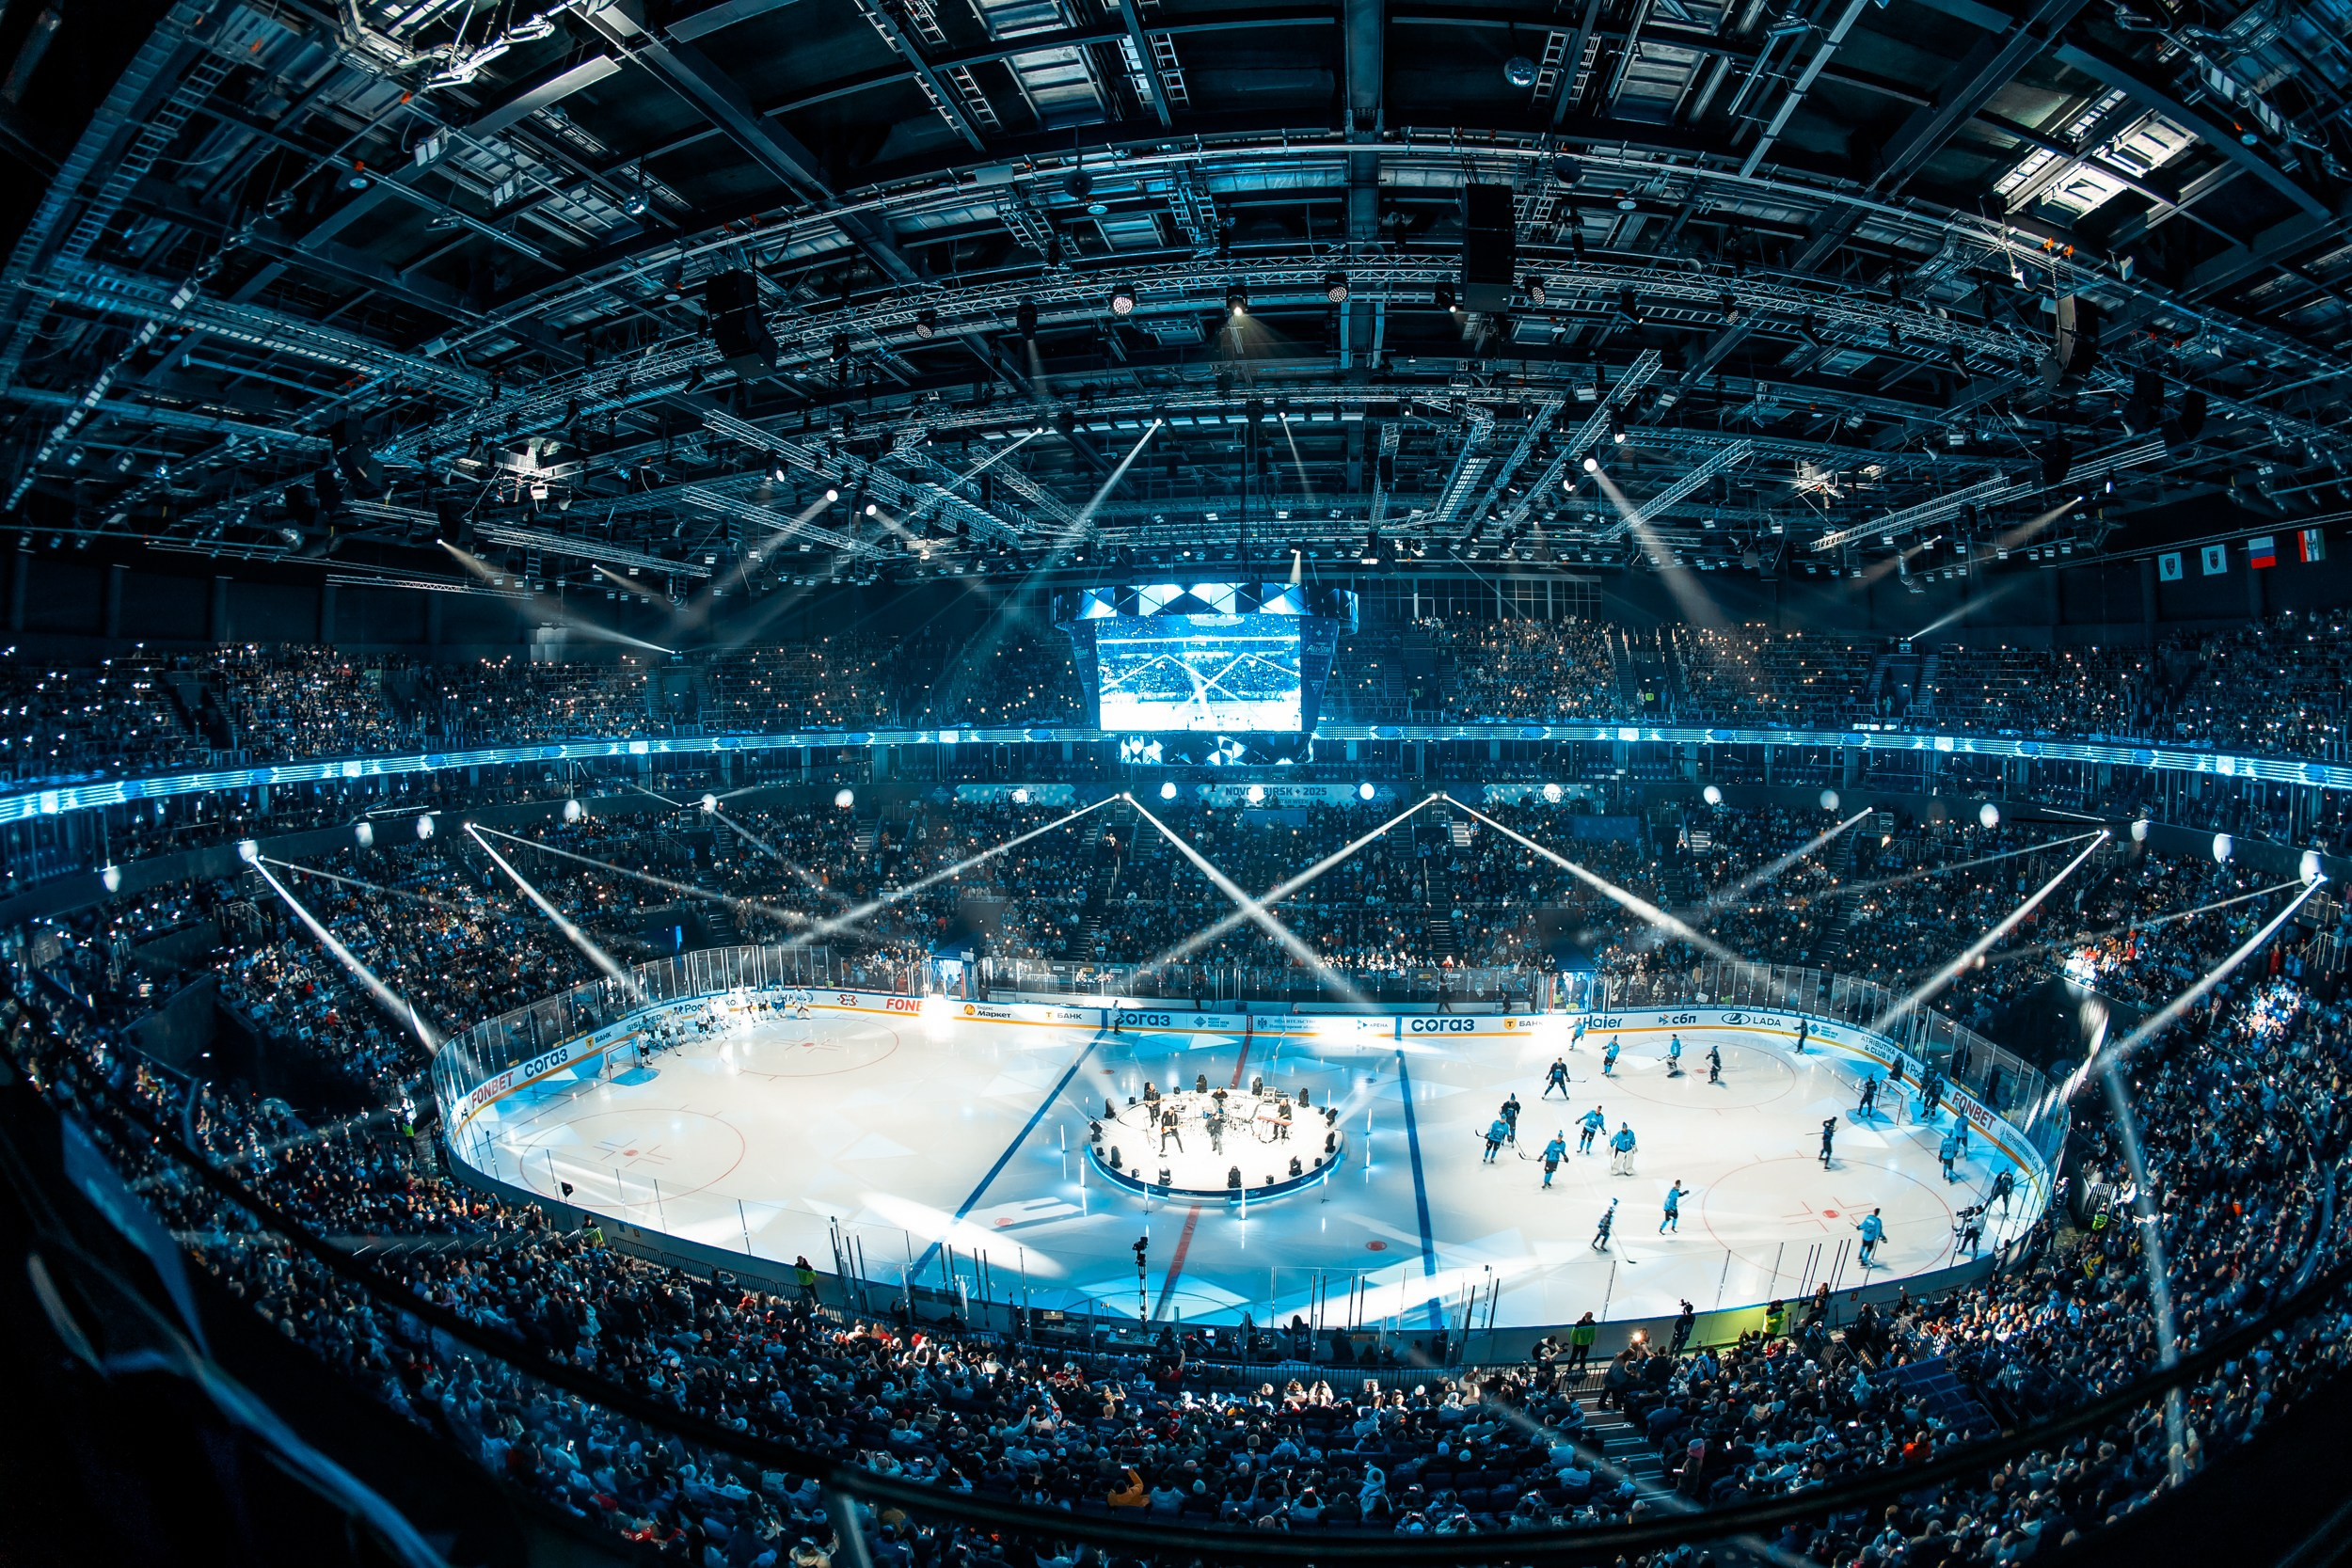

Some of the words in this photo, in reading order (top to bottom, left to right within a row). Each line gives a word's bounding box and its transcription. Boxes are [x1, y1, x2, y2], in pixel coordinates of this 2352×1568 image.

[1303, 787, 1327, 796] 2025
[977, 1010, 1011, 1019] Маркет
[1583, 1015, 1623, 1029] Haier
[1753, 1017, 1782, 1027] LADA
[595, 1031, 612, 1044] БАНК
[1861, 1036, 1896, 1055] ATRIBUTIKA
[1870, 1047, 1886, 1059] CLUB
[471, 1070, 514, 1109] FONBET
[1951, 1091, 1997, 1131] FONBET
